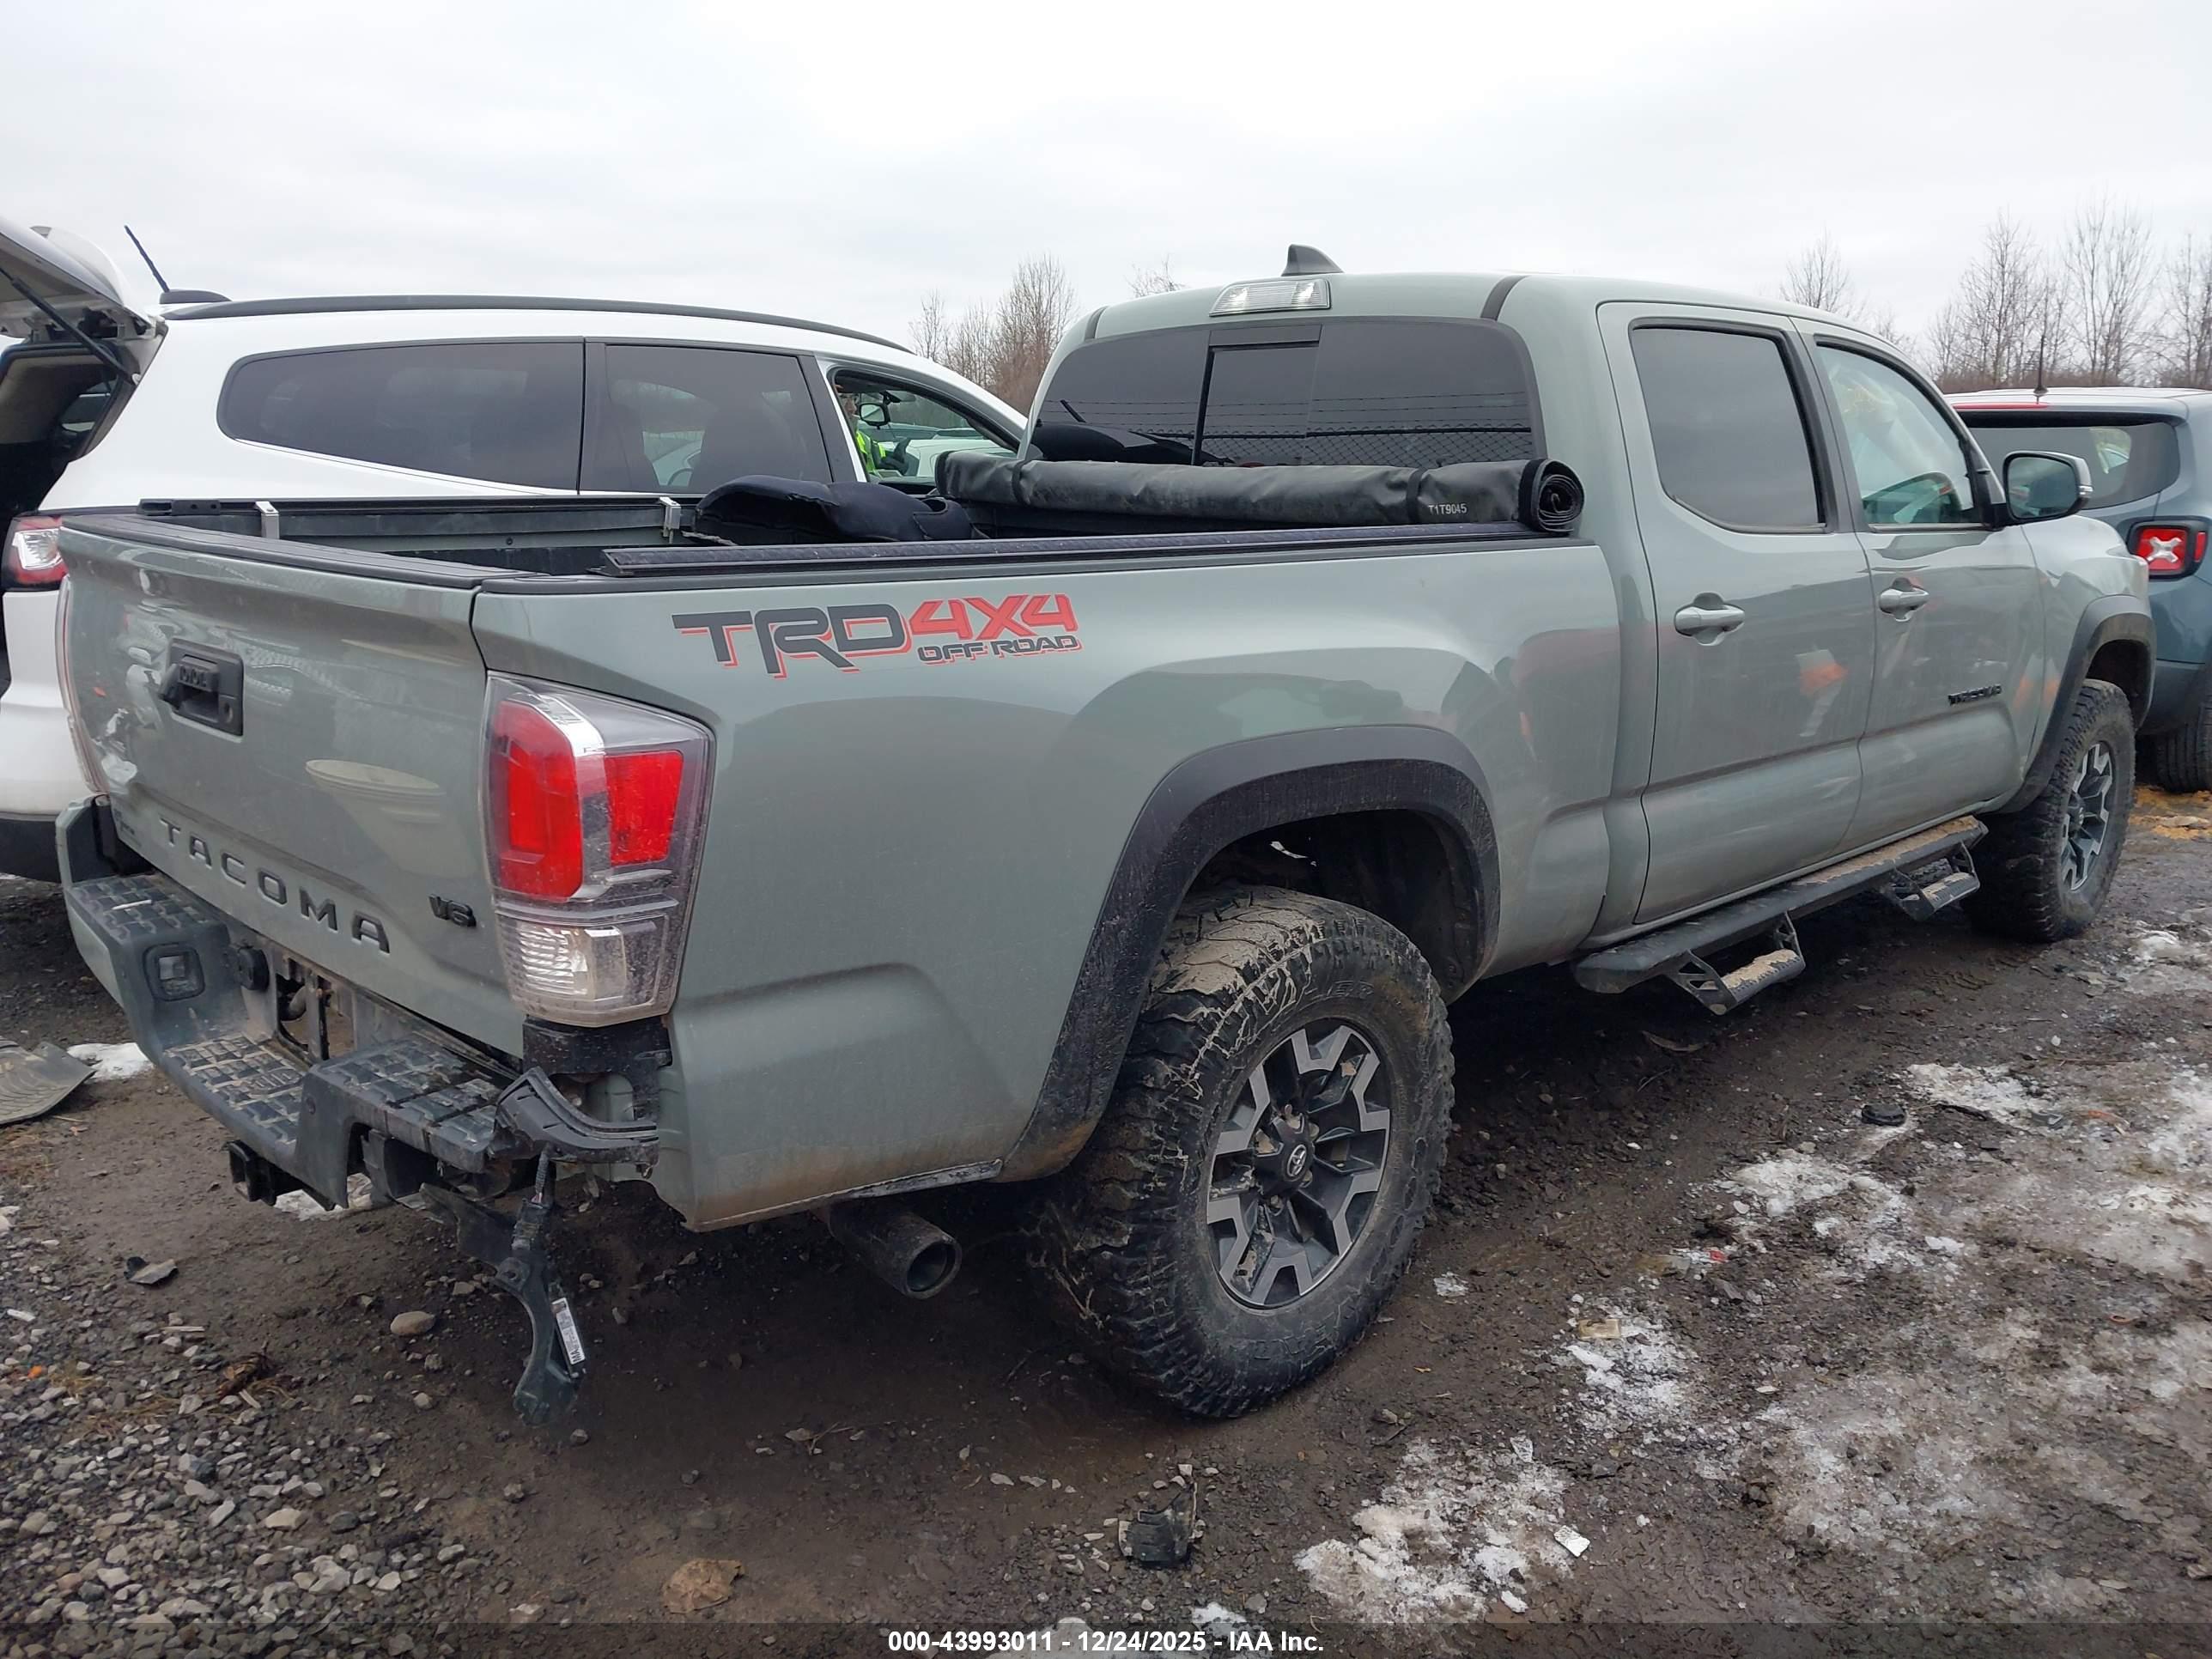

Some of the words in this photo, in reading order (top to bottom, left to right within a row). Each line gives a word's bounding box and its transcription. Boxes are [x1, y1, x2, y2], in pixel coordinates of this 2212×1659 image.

[1428, 502, 1468, 515] T1T9045
[672, 603, 912, 679] TRD
[908, 593, 1079, 641] 4X4
[917, 641, 988, 665] OFF
[988, 635, 1083, 659] ROAD
[159, 817, 391, 955] TACOMA
[428, 894, 477, 927] V6
